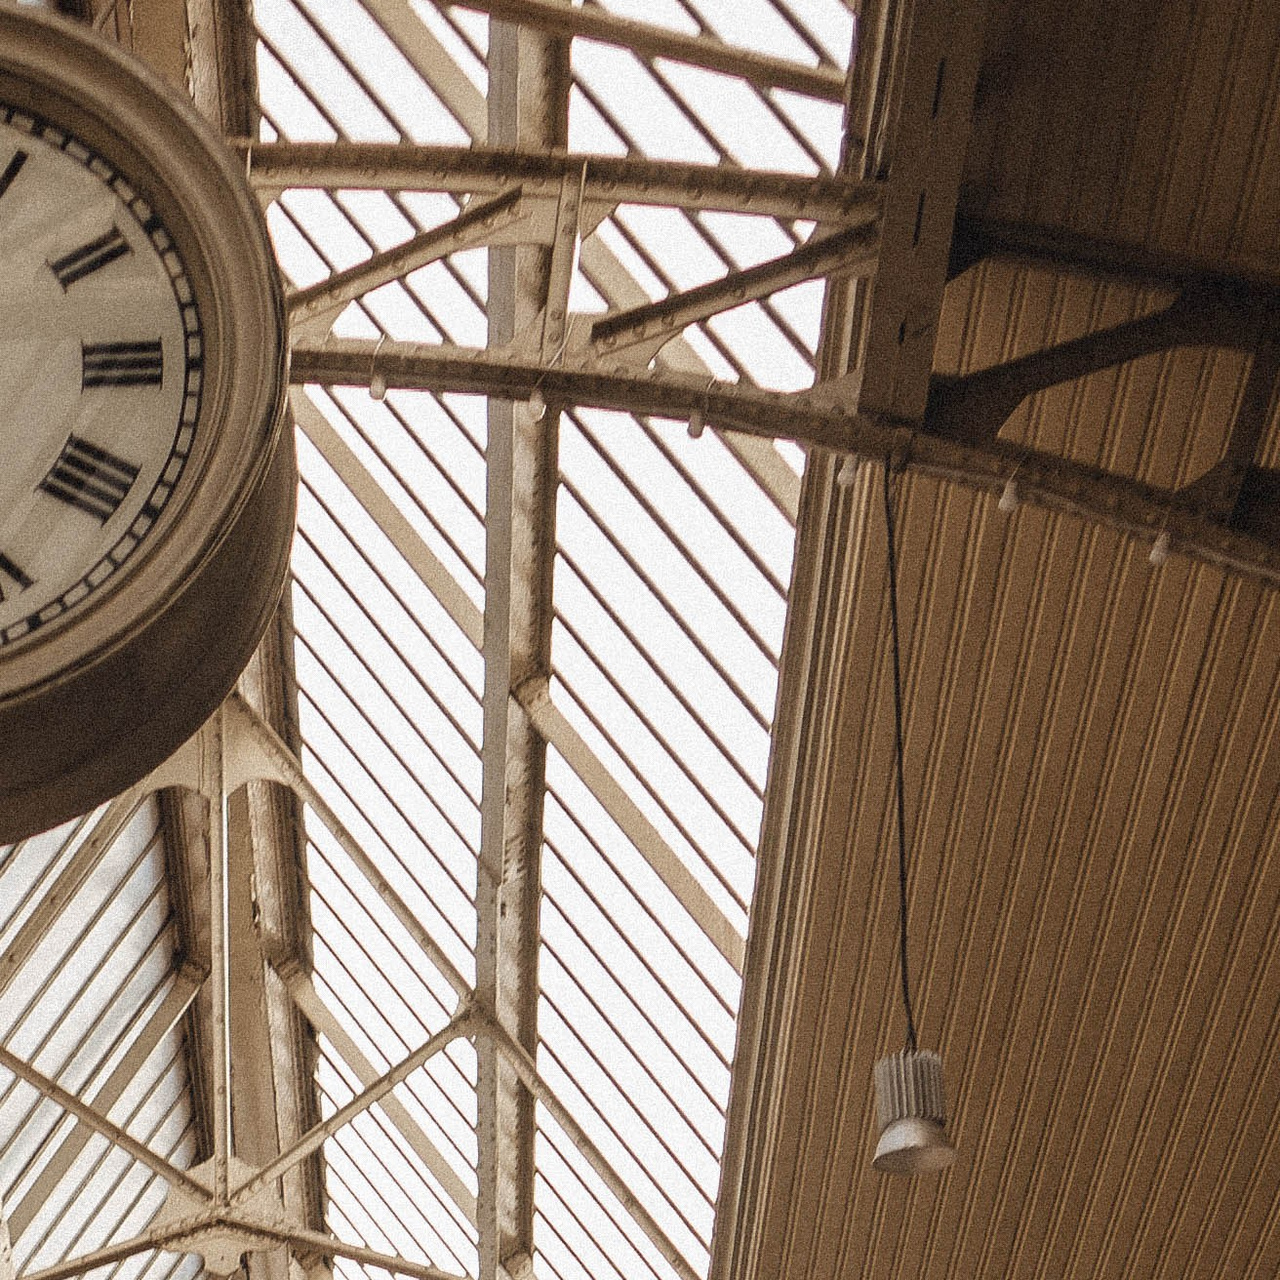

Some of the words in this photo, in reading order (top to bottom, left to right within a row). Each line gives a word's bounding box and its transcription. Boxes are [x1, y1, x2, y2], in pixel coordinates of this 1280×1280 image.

[46, 225, 132, 292] II
[81, 336, 165, 391] III
[36, 432, 143, 527] IIII
